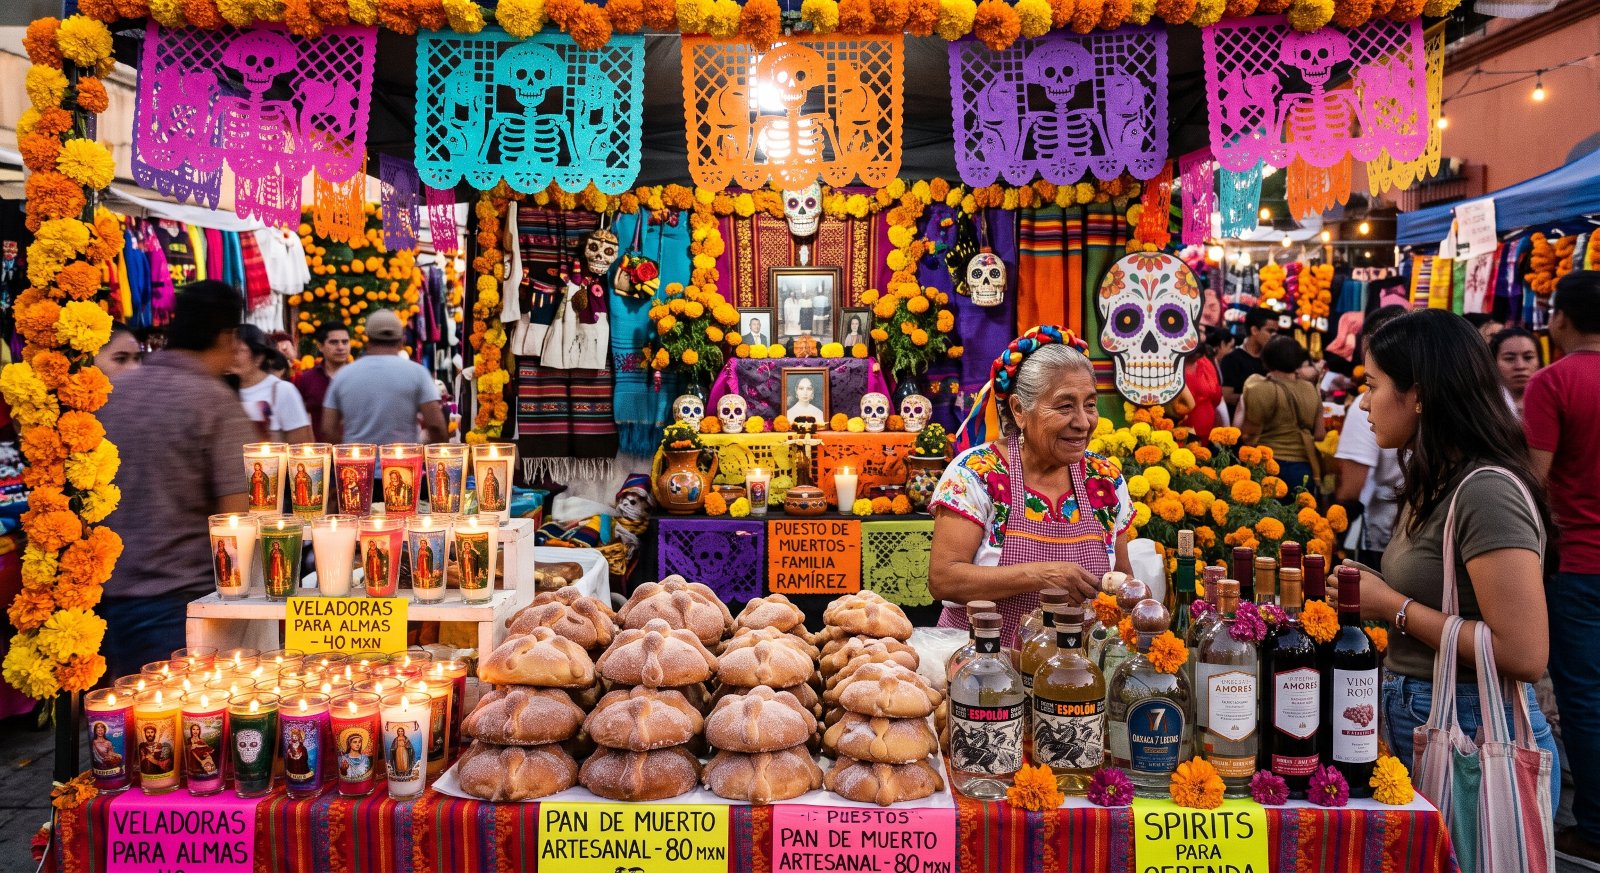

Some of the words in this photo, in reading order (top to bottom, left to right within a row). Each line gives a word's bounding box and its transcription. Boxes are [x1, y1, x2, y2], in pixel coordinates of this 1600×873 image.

[775, 522, 827, 535] PUESTO
[832, 522, 849, 535] DE
[779, 539, 846, 552] MUERTOS
[776, 570, 847, 589] RAMÍREZ
[293, 600, 393, 616] VELADORAS
[294, 619, 332, 632] PARA
[340, 619, 391, 632] ALMAS
[323, 635, 346, 649] 40
[351, 637, 381, 649] MXN
[1215, 684, 1252, 693] AMORES
[1283, 681, 1317, 690] AMORES
[1346, 677, 1374, 686] VINO
[1346, 688, 1374, 698] ROJO
[1150, 708, 1166, 731] 7
[113, 810, 246, 834] VELADORAS
[546, 810, 588, 832] PAN
[600, 811, 624, 832] DE
[635, 811, 716, 832] MUERTO
[1144, 812, 1254, 840] SPIRITS
[781, 828, 818, 848] PAN
[829, 829, 851, 848] DE
[861, 830, 938, 849] MUERTO
[113, 841, 166, 864] PARA
[176, 841, 248, 864] ALMAS
[696, 846, 725, 860] MXN
[1175, 844, 1222, 860] PARA
